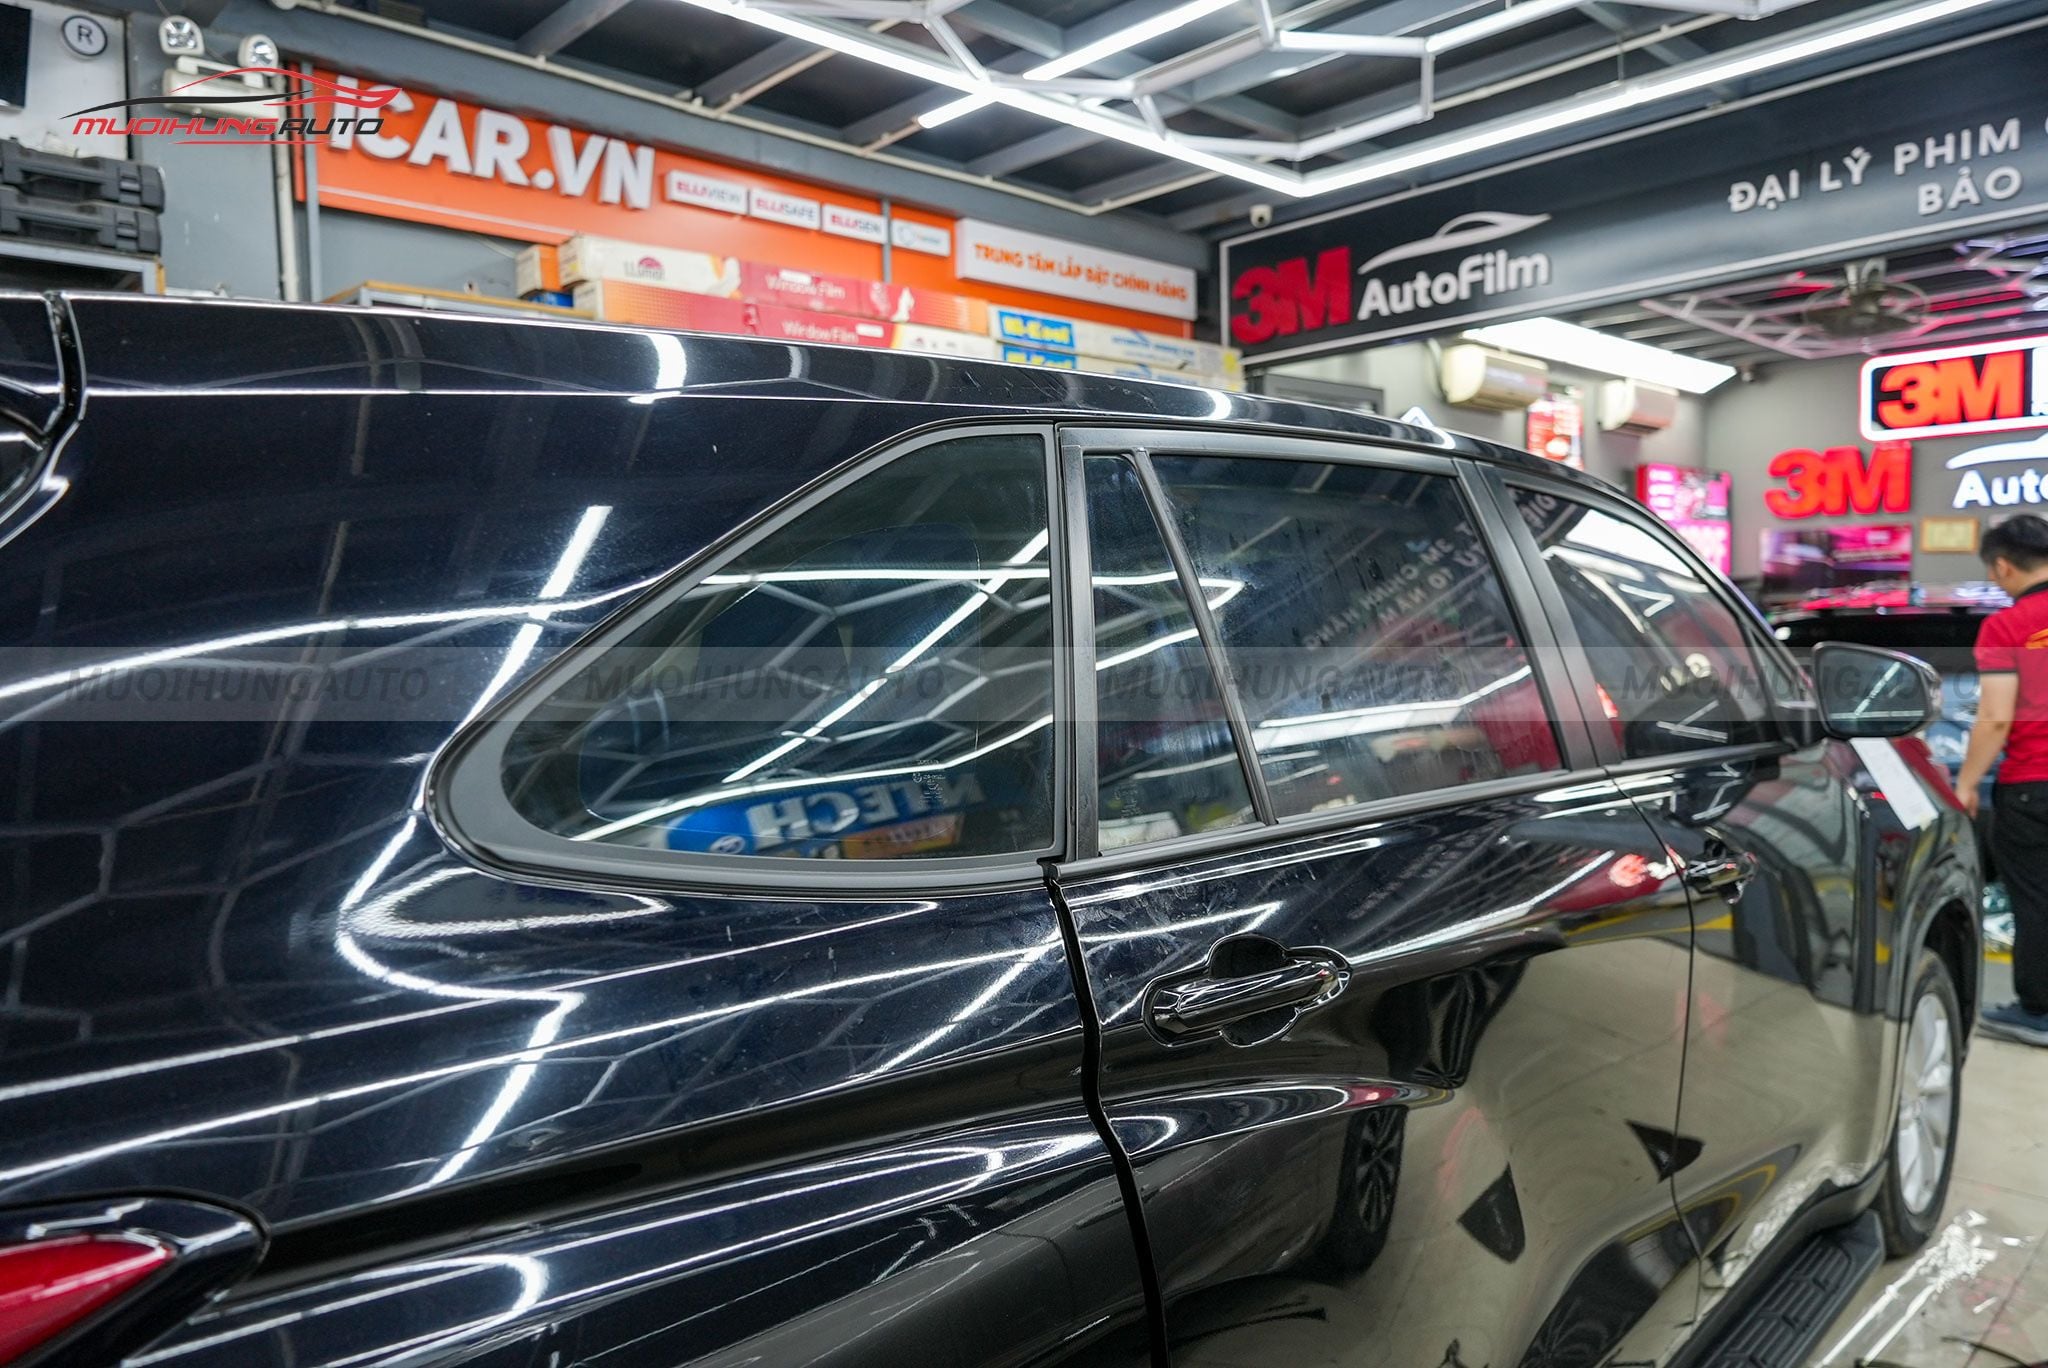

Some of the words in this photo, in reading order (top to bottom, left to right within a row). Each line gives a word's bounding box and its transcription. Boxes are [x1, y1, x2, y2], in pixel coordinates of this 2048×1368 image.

[1727, 168, 1799, 213] ĐẠI
[1819, 146, 1872, 192] LÝ
[1893, 117, 2021, 176] PHIM
[1917, 166, 2023, 216] BẢO
[973, 243, 1024, 268] TRUNG
[1230, 245, 1351, 344] 3M
[1357, 249, 1551, 321] AutoFilm
[1877, 350, 2025, 429] 3M
[1764, 442, 1912, 520] 3M
